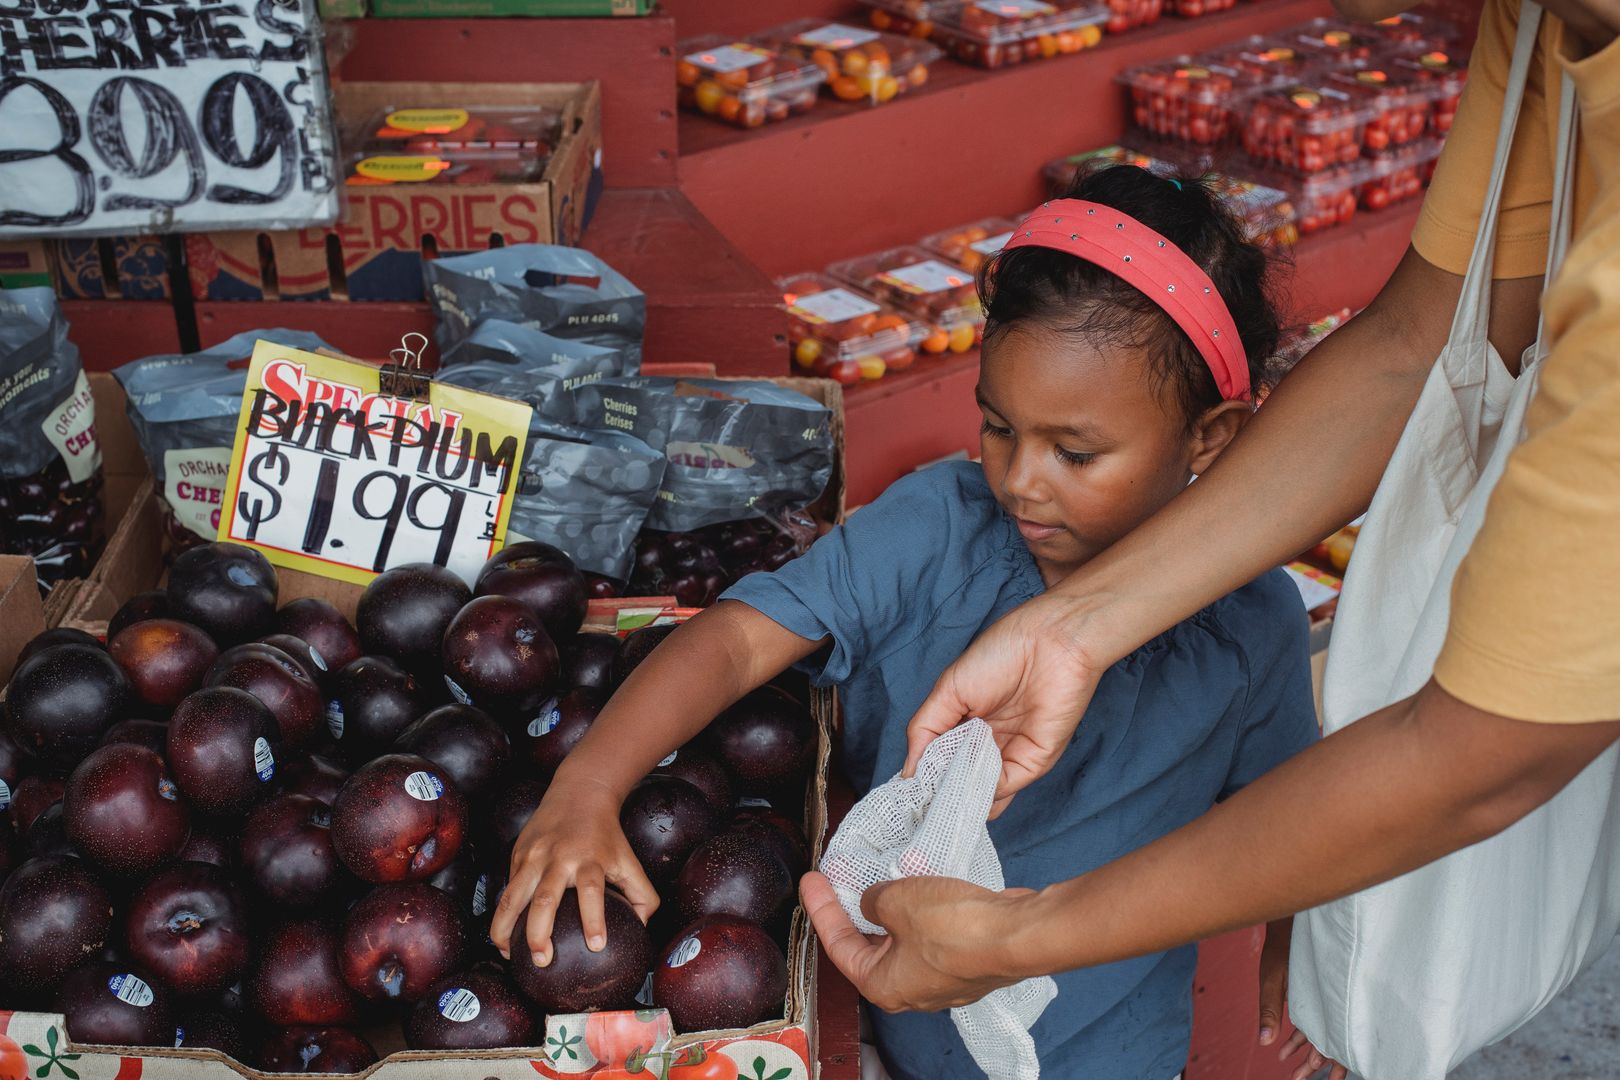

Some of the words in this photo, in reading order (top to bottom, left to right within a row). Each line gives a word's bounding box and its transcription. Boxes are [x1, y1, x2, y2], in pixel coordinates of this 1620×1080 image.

[603, 397, 638, 416] Cherries
[604, 412, 634, 431] Cerises
[238, 444, 467, 573] $1.99
